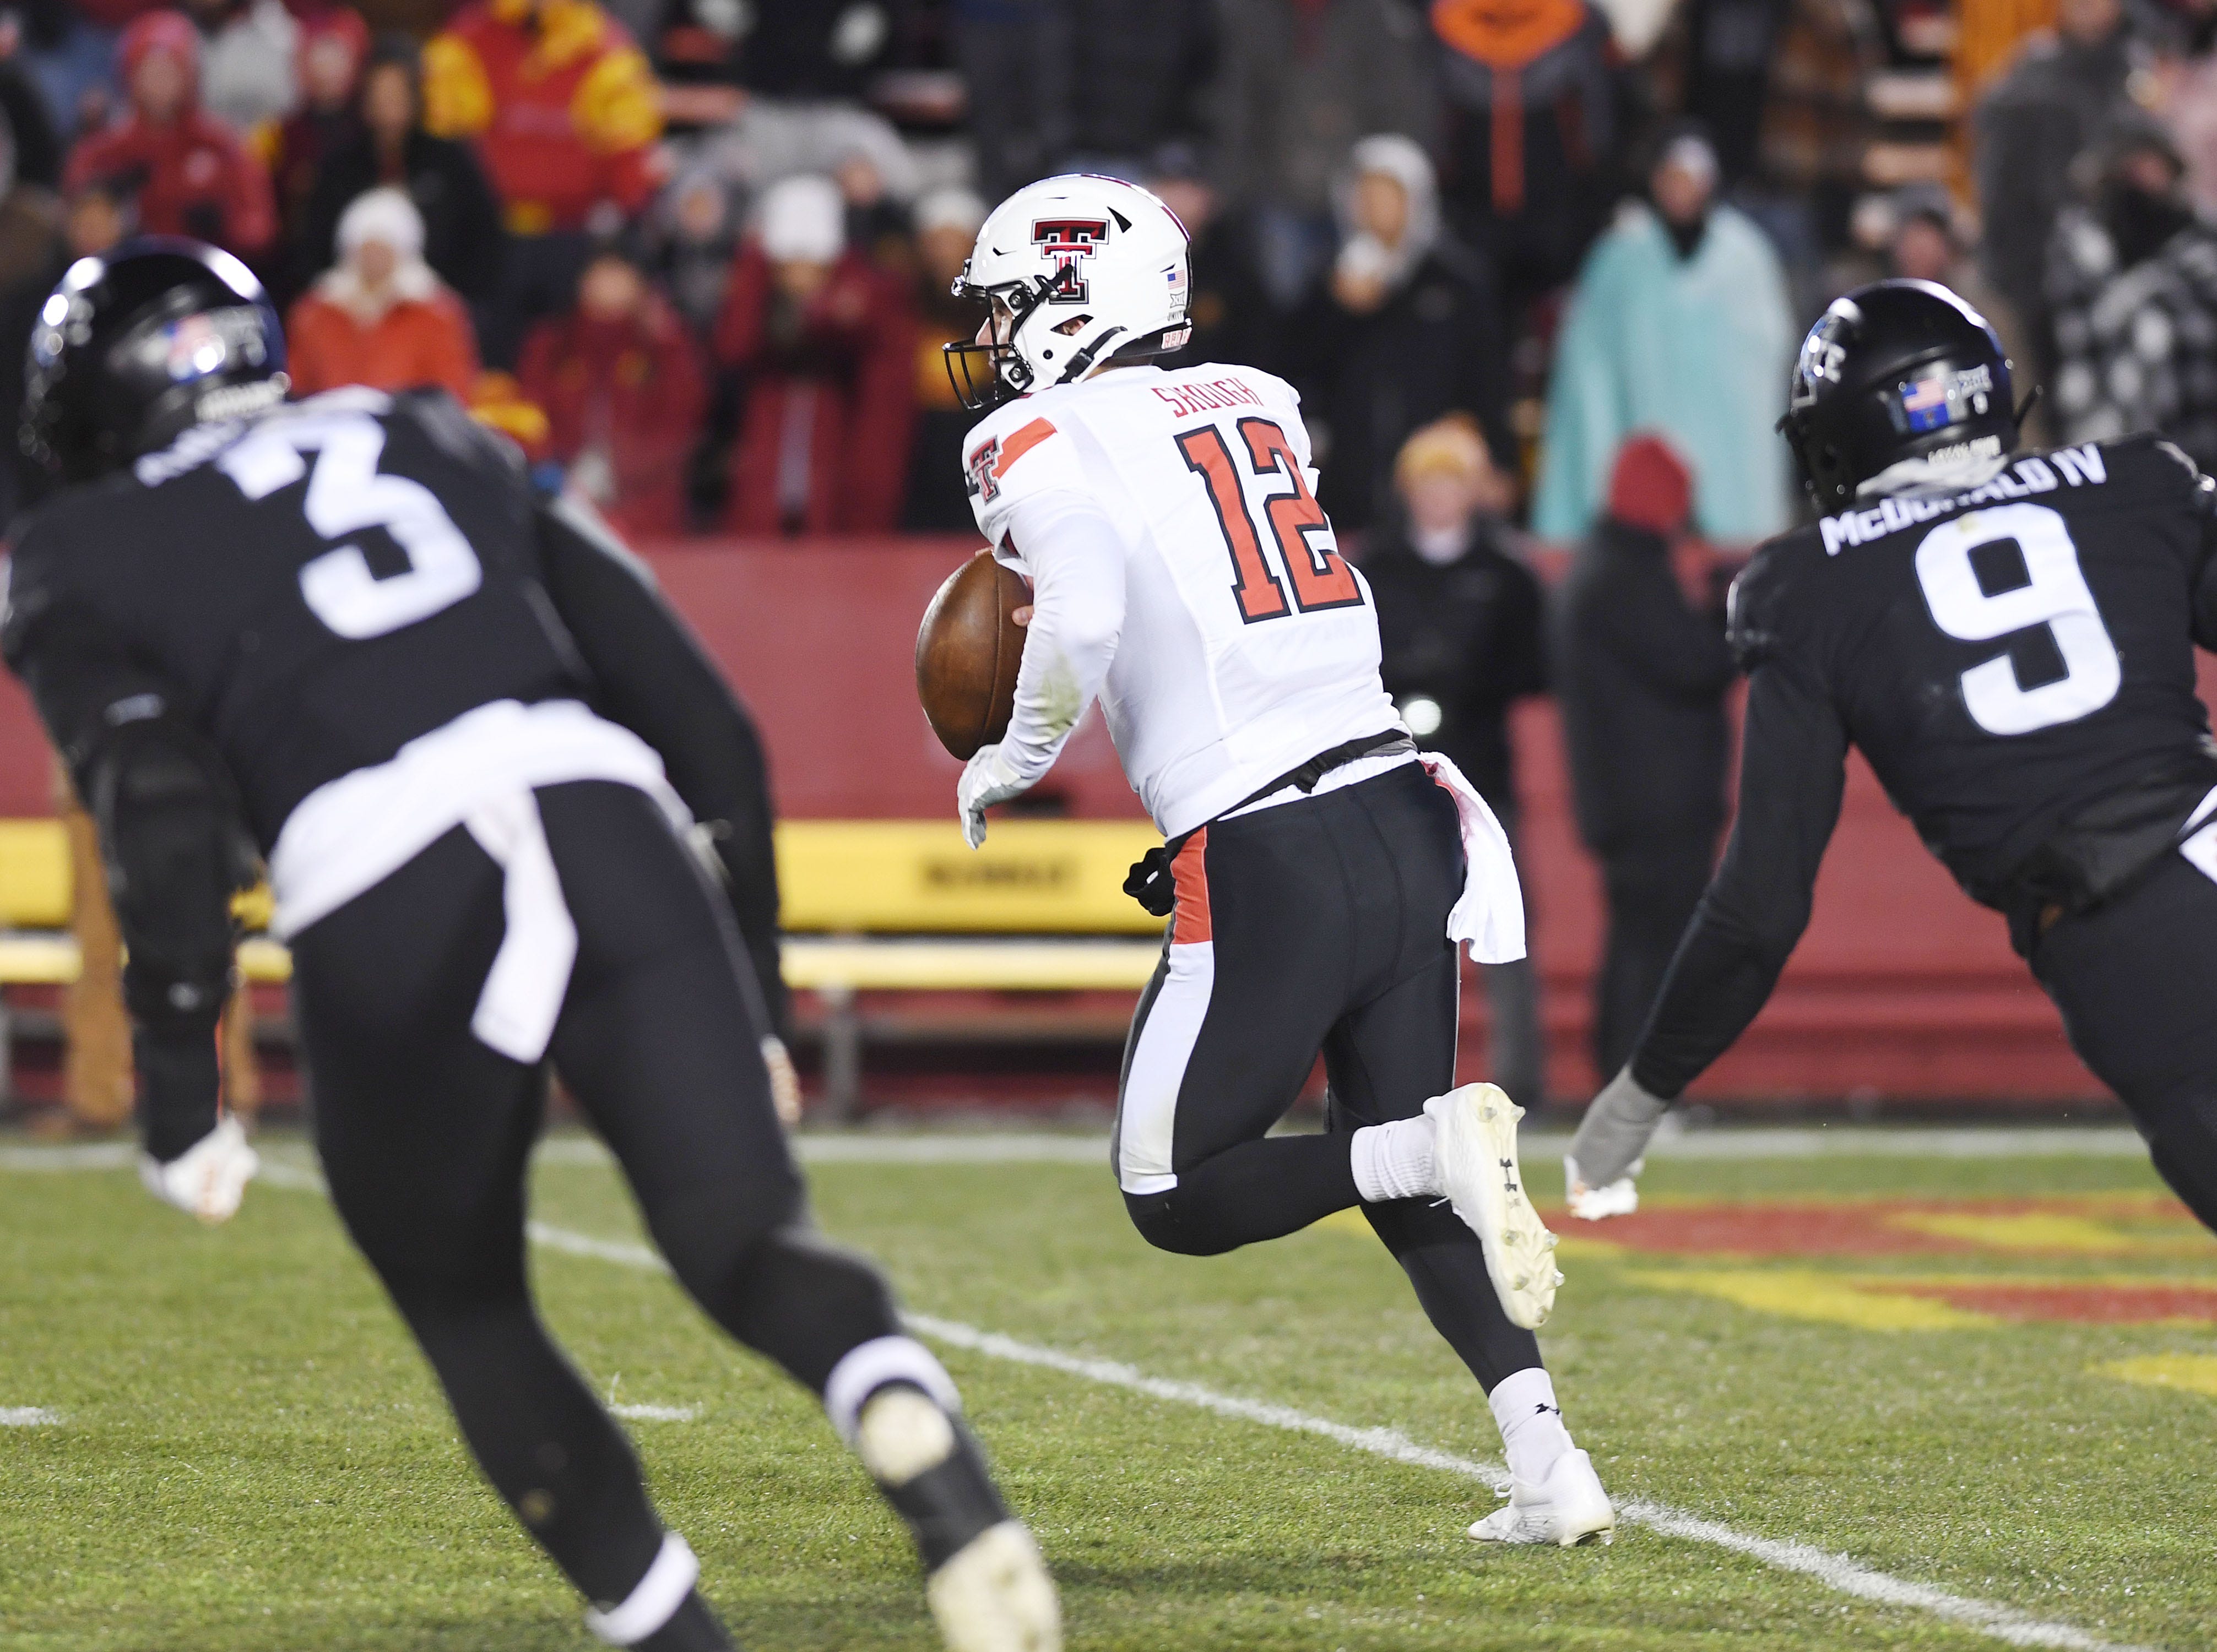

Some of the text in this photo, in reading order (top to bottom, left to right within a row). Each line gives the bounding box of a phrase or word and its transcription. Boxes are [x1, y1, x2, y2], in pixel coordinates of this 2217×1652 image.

[1151, 377, 1264, 417] SHOUGH
[1819, 458, 2057, 556] McDOALD
[2050, 443, 2106, 486] IV
[218, 410, 483, 640] 3
[1173, 417, 1365, 624] 12
[1916, 502, 2121, 735] 9
